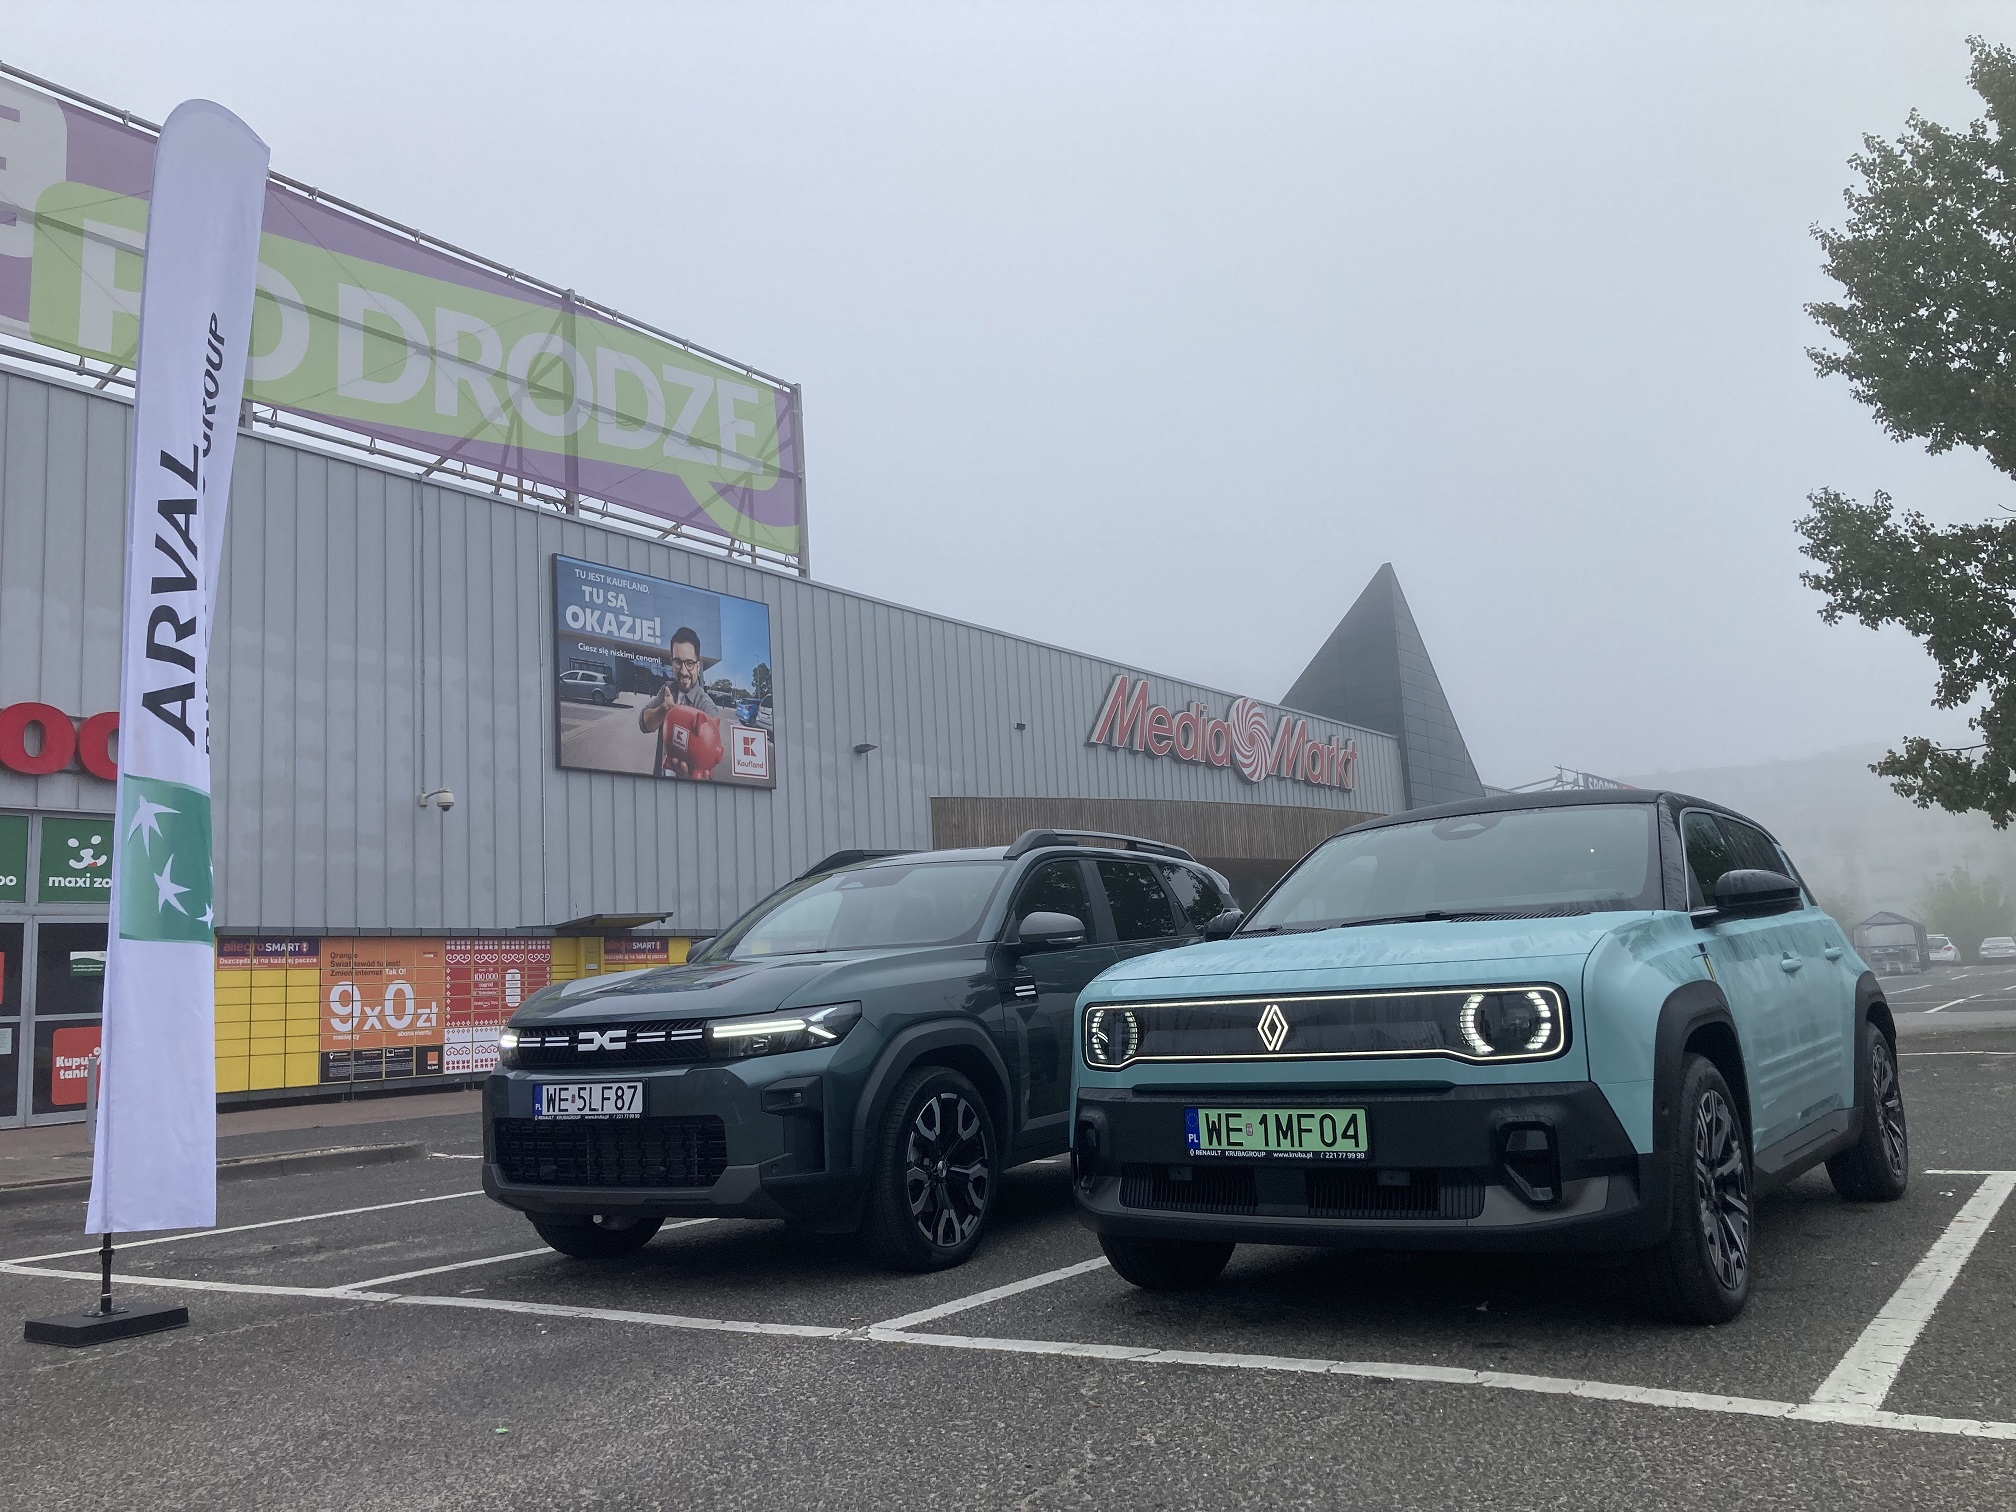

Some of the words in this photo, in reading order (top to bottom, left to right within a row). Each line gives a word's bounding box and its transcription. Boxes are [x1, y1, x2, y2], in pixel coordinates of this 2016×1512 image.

[338, 283, 764, 474] DRODZE
[574, 568, 587, 579] TU
[587, 572, 606, 584] JEST
[606, 576, 651, 595] KAUFLAND,
[142, 443, 200, 748] ARVAL
[581, 585, 604, 605] TU
[607, 591, 629, 614] SĄ
[565, 604, 662, 645] OKAZJE!
[578, 642, 598, 653] Ciesz
[598, 646, 610, 657] się
[610, 649, 635, 660] niskimi
[635, 654, 663, 665] cenami.
[1088, 674, 1231, 768] Media
[1268, 715, 1357, 789] Markt
[737, 759, 764, 769] Kaufland
[48, 873, 91, 888] maxi
[330, 952, 358, 960] Orange
[385, 967, 397, 976] Tak
[56, 1054, 92, 1070] Kupu
[546, 1087, 569, 1112] WE
[576, 1085, 638, 1112] 5LF87
[1188, 1133, 1199, 1143] PL
[1205, 1112, 1244, 1147] WE
[1258, 1113, 1360, 1148] 1MF04
[1195, 1149, 1221, 1157] RENAULT
[1225, 1150, 1266, 1158] KRUBAGROUP
[1272, 1151, 1313, 1159] www.kruba.pl
